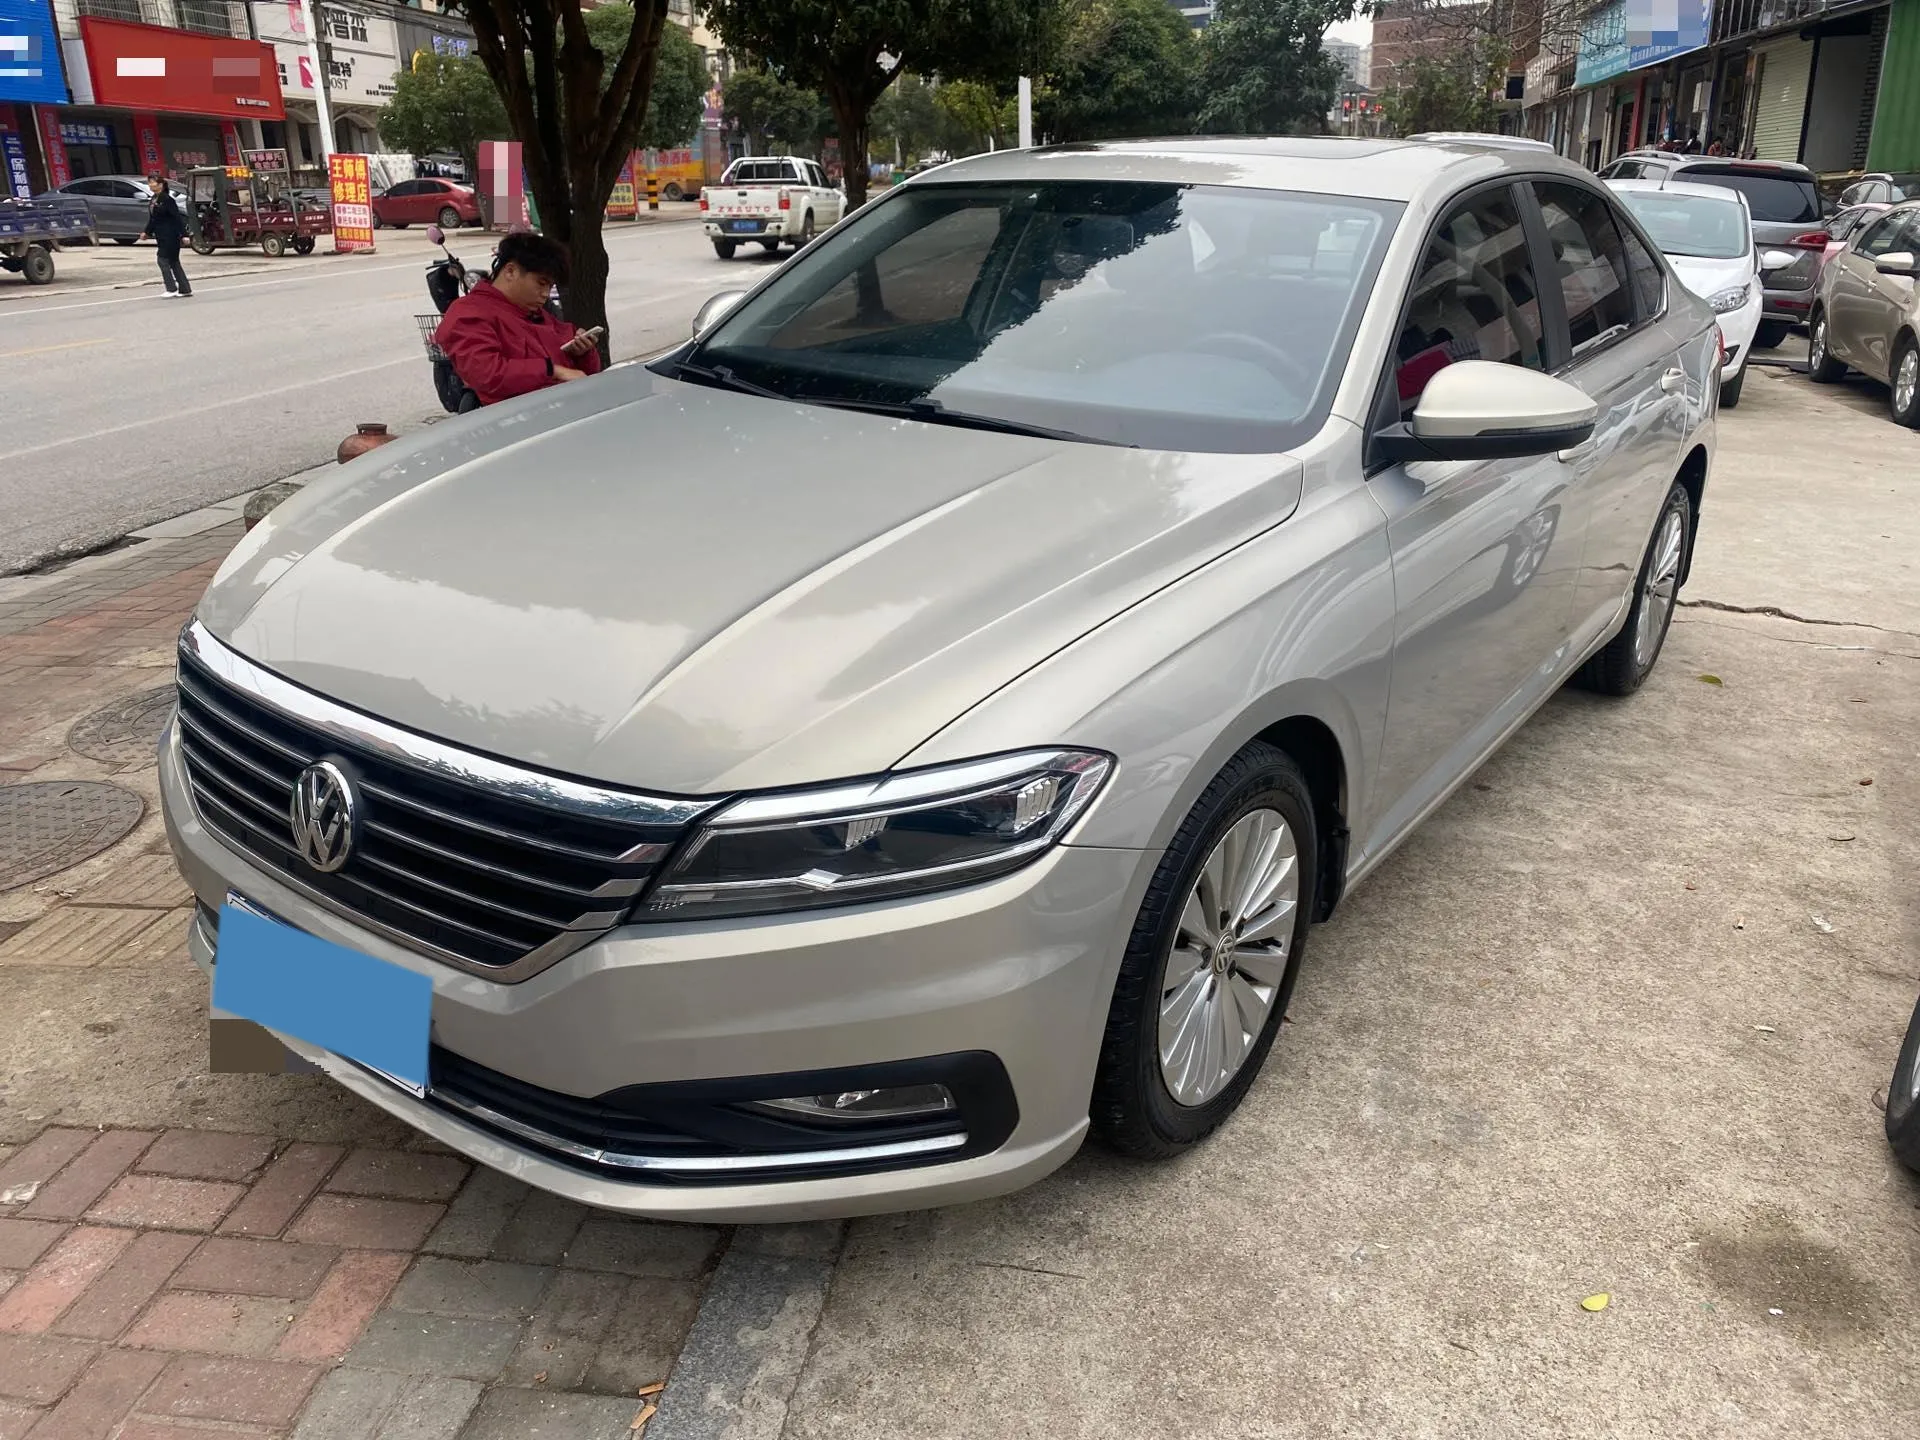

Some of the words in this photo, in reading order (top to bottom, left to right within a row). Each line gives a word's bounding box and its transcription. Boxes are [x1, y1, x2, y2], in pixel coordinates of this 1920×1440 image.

[332, 158, 367, 181] 王师傅
[333, 181, 368, 203] 修理店
